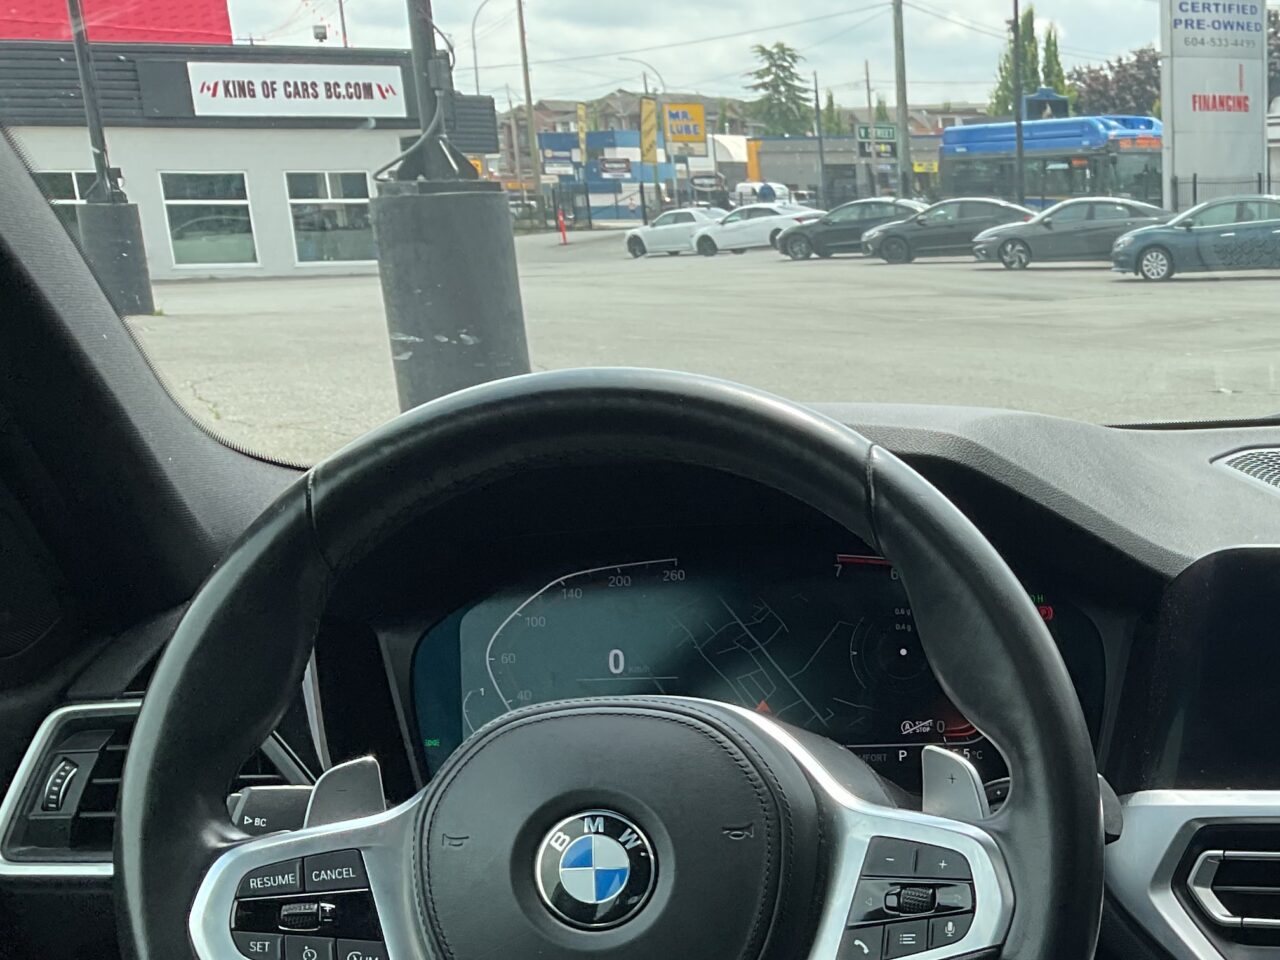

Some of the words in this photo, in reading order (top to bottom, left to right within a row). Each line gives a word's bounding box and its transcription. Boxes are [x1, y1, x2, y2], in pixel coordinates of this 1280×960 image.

[1178, 2, 1258, 15] CERTIFIED
[1173, 18, 1263, 32] PRE-OWNED
[222, 80, 256, 98] KING
[261, 81, 277, 98] OF
[283, 81, 319, 99] CARS
[324, 82, 373, 100] BC.COM
[1191, 94, 1250, 113] FINANCING
[662, 569, 686, 582] 260
[834, 564, 842, 577] 7
[890, 568, 899, 580] 6
[608, 575, 632, 588] 200
[561, 588, 583, 599] 140
[525, 616, 546, 627] 100
[501, 653, 516, 664] 60
[608, 649, 625, 674] 0
[517, 690, 532, 701] 40
[936, 720, 945, 734] 0
[899, 750, 908, 762] P
[254, 817, 267, 827] BC
[549, 816, 643, 852] BMW
[249, 872, 296, 889] RESUME
[312, 867, 356, 882] CANCEL
[249, 941, 270, 952] SET
